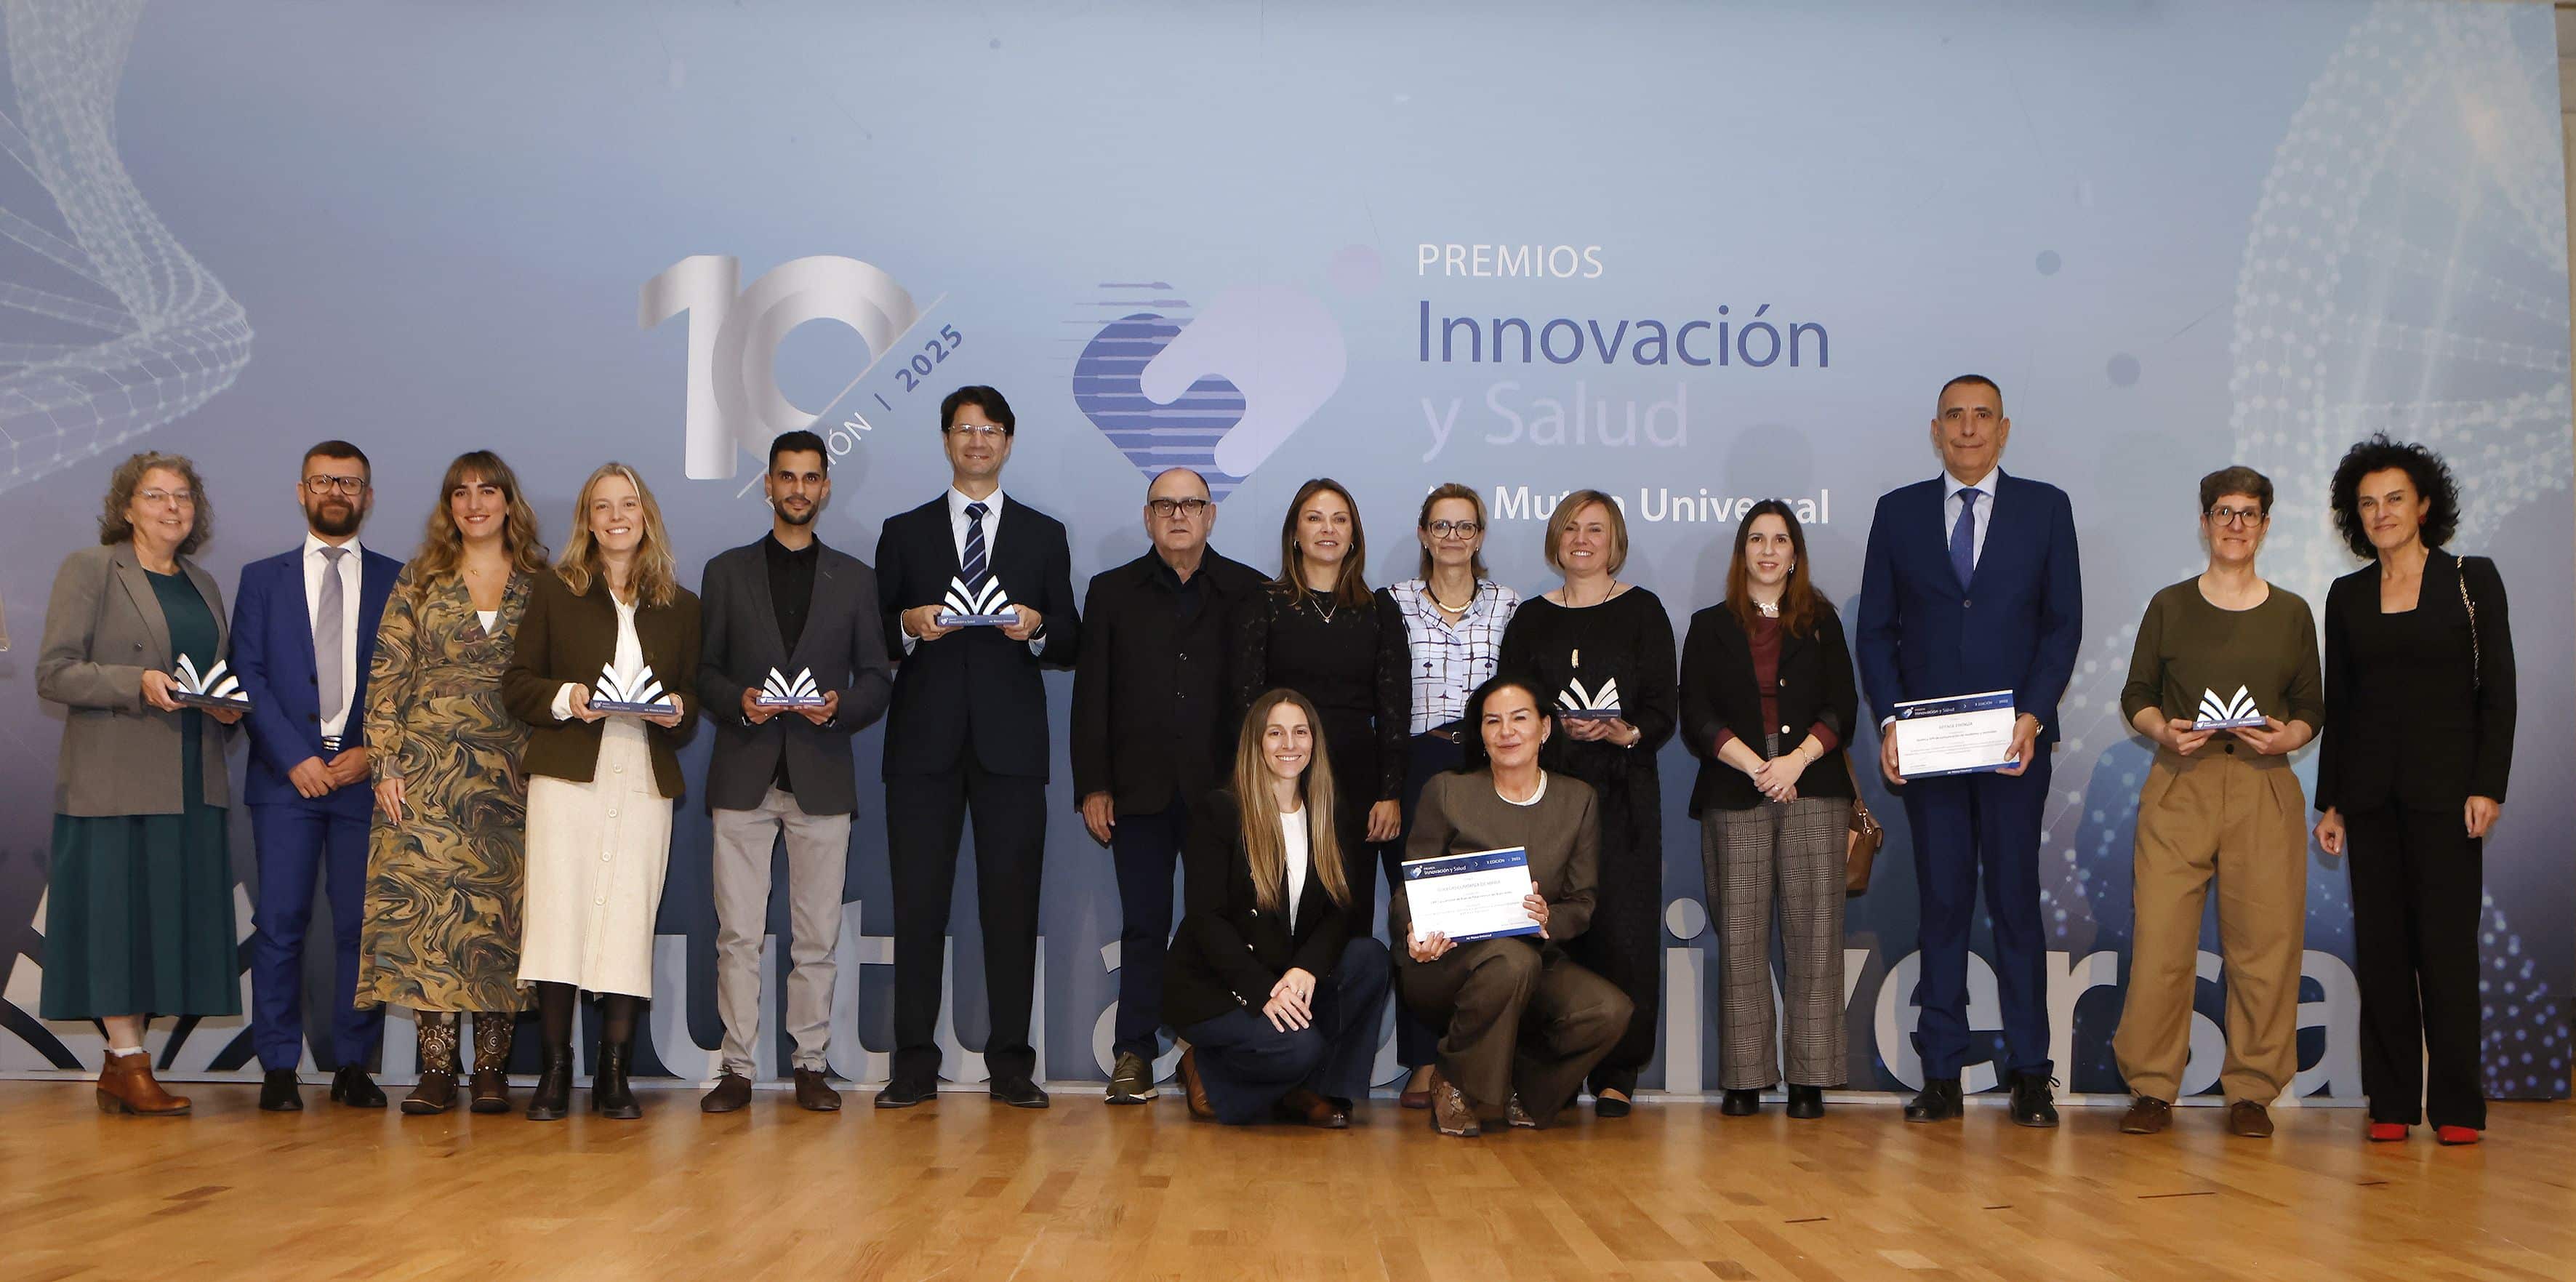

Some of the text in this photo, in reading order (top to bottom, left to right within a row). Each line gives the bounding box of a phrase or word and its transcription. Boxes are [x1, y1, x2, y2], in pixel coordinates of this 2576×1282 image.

[1419, 244, 1604, 279] PREMIOS
[894, 324, 963, 393] 2025
[1420, 300, 1829, 368] Innovación
[1421, 379, 1688, 463] y Salud
